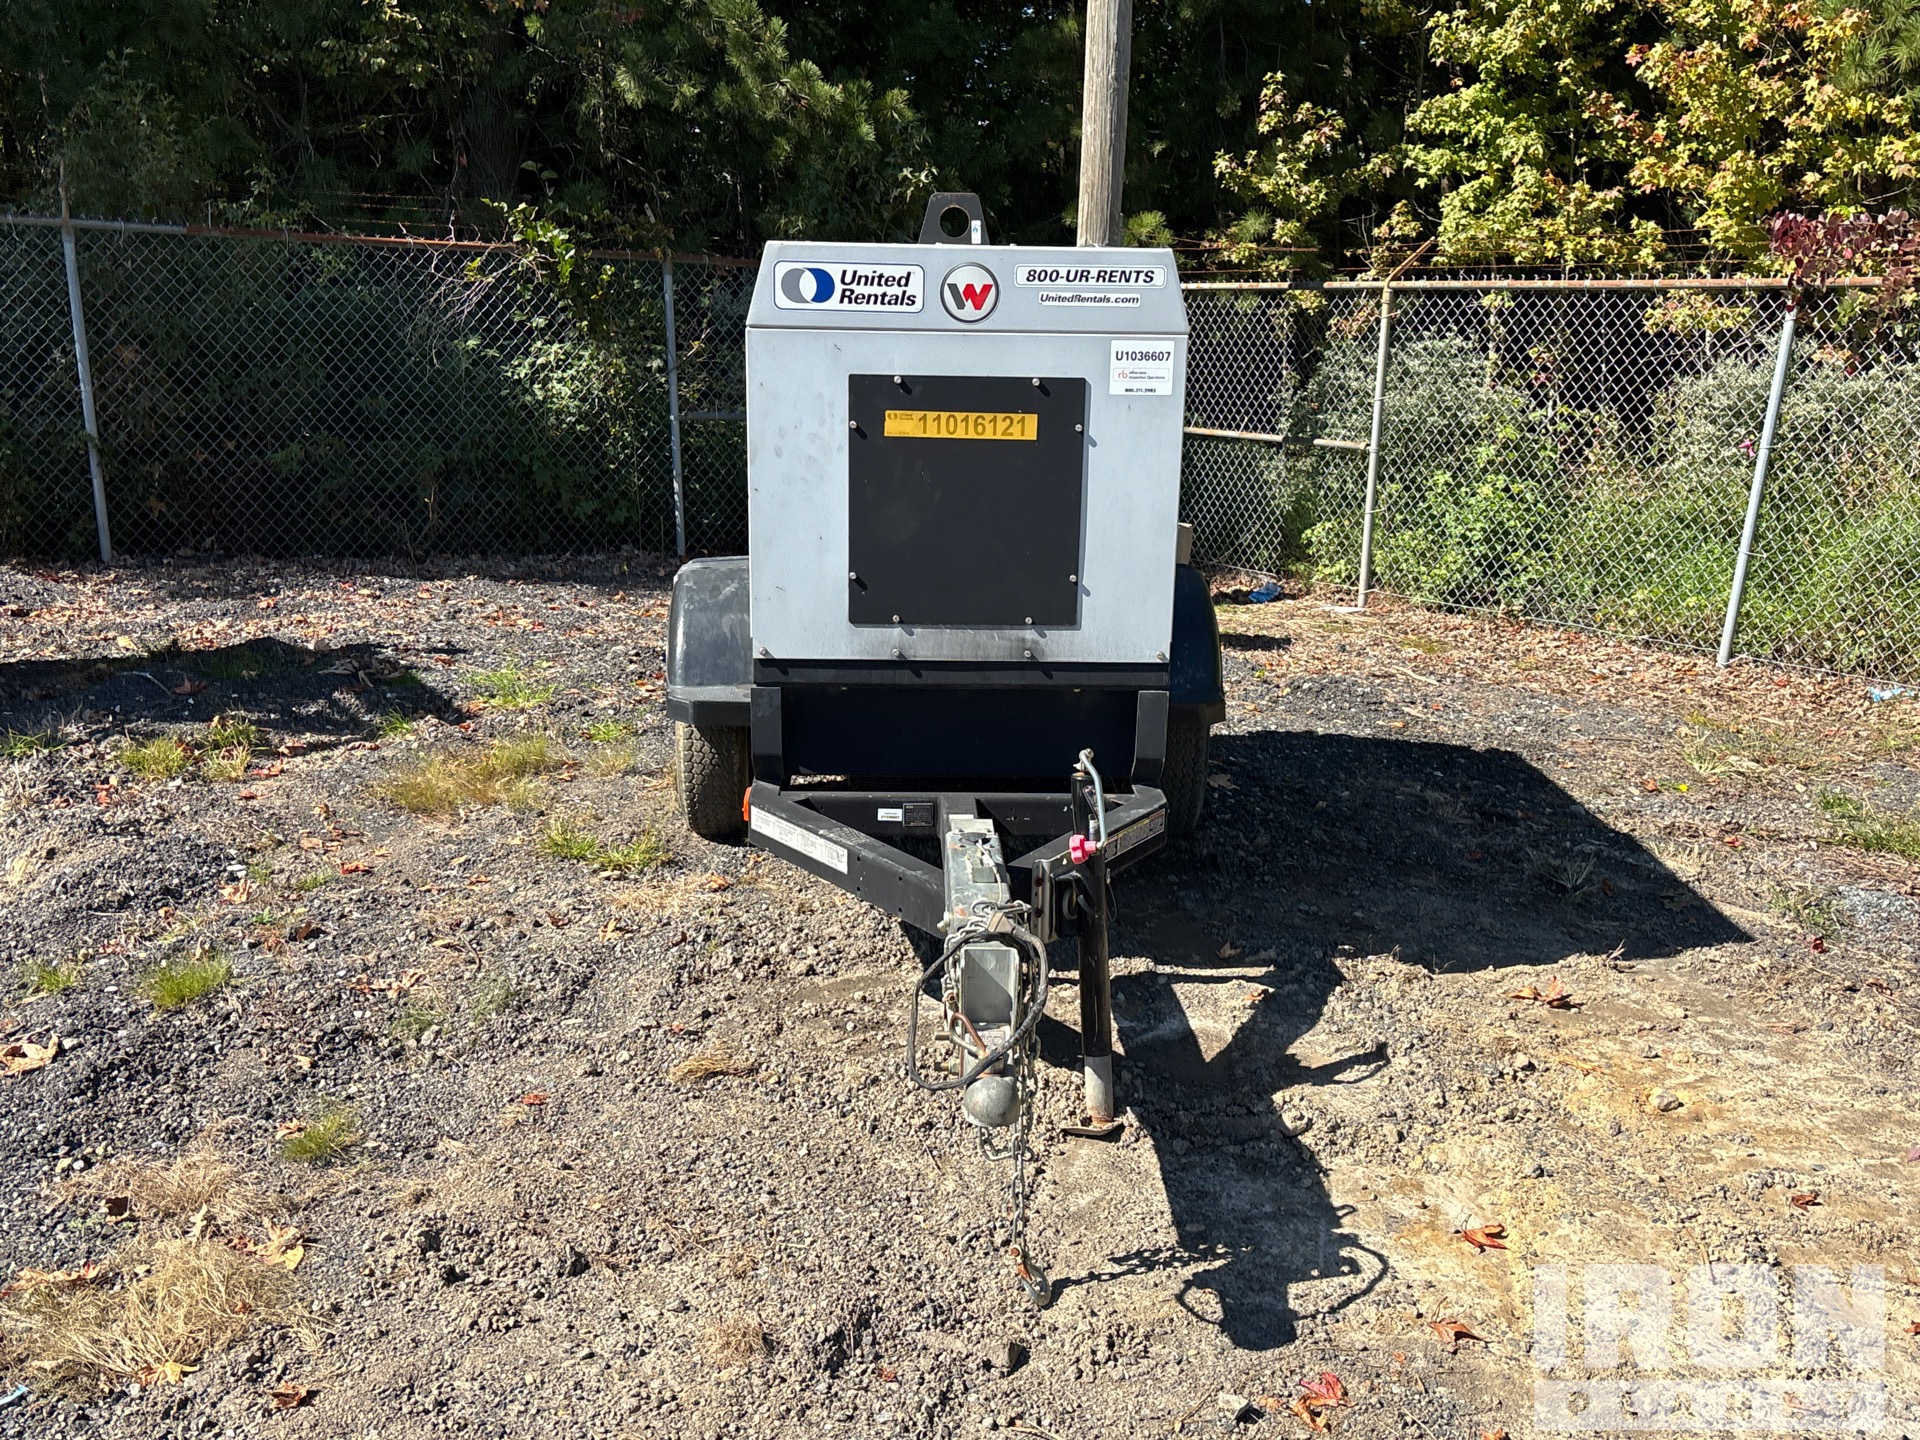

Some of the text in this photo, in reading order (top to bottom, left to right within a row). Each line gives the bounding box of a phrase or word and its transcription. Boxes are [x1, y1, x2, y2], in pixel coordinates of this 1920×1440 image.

[840, 269, 912, 288] United
[1025, 269, 1155, 284] 800-UR-RENTS
[838, 288, 917, 306] Rentals
[1040, 293, 1140, 304] UnitedRentals.com
[1115, 350, 1172, 362] U1036607
[918, 413, 1026, 437] 11016121
